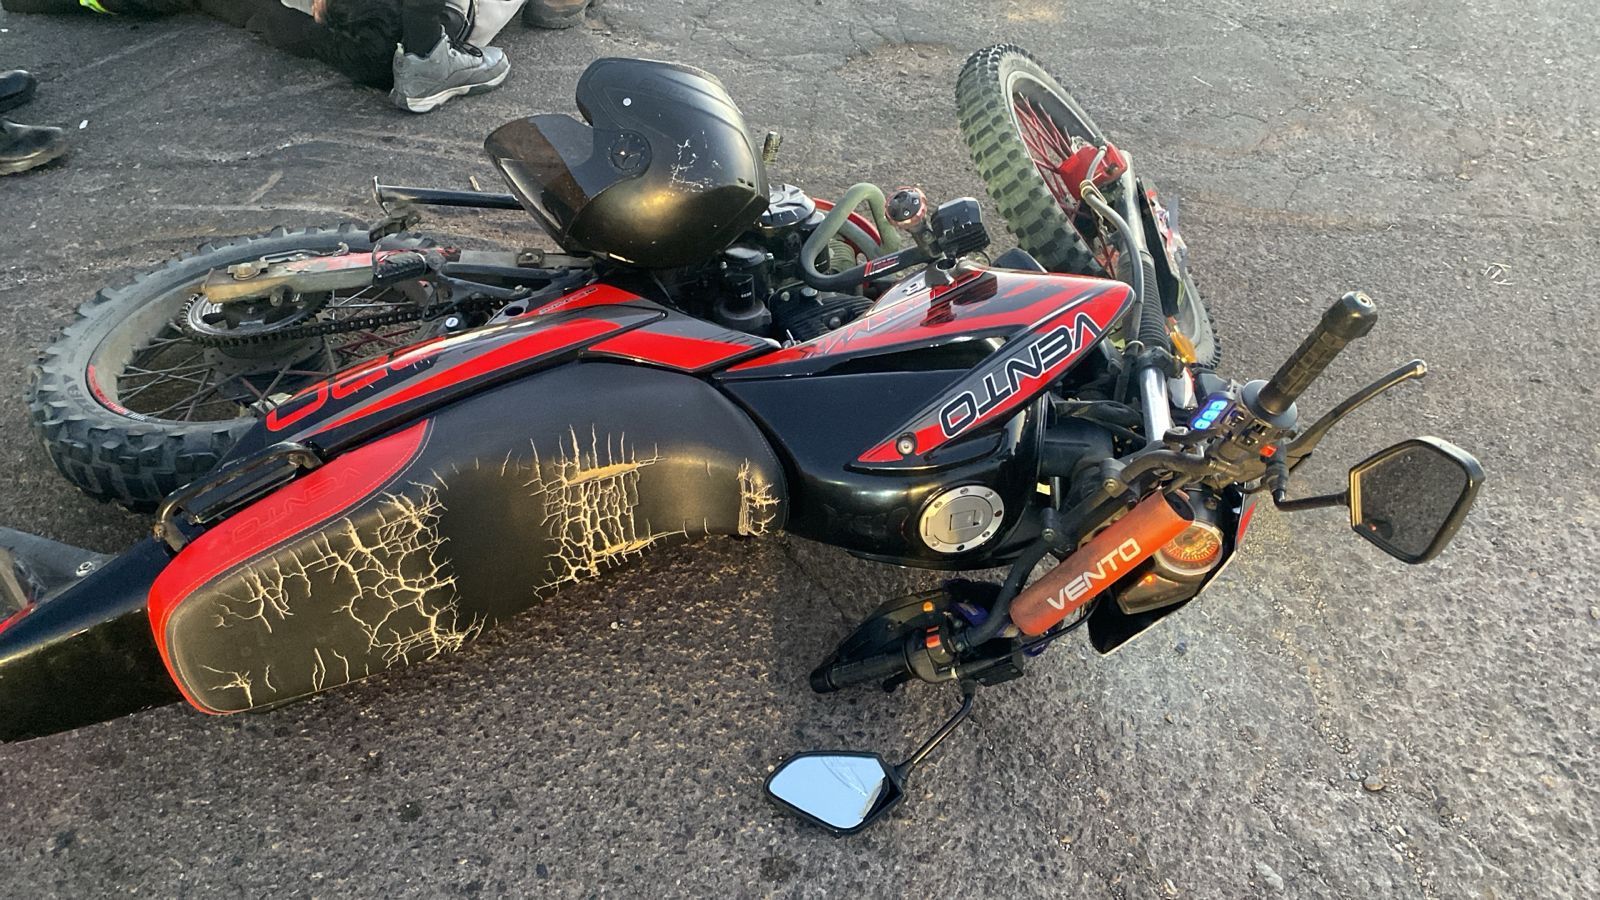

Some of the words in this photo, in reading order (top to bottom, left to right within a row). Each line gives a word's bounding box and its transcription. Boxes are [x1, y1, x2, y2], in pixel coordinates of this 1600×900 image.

[939, 312, 1102, 438] VENTO
[231, 467, 361, 542] VENTO
[1046, 538, 1141, 610] VENTO
